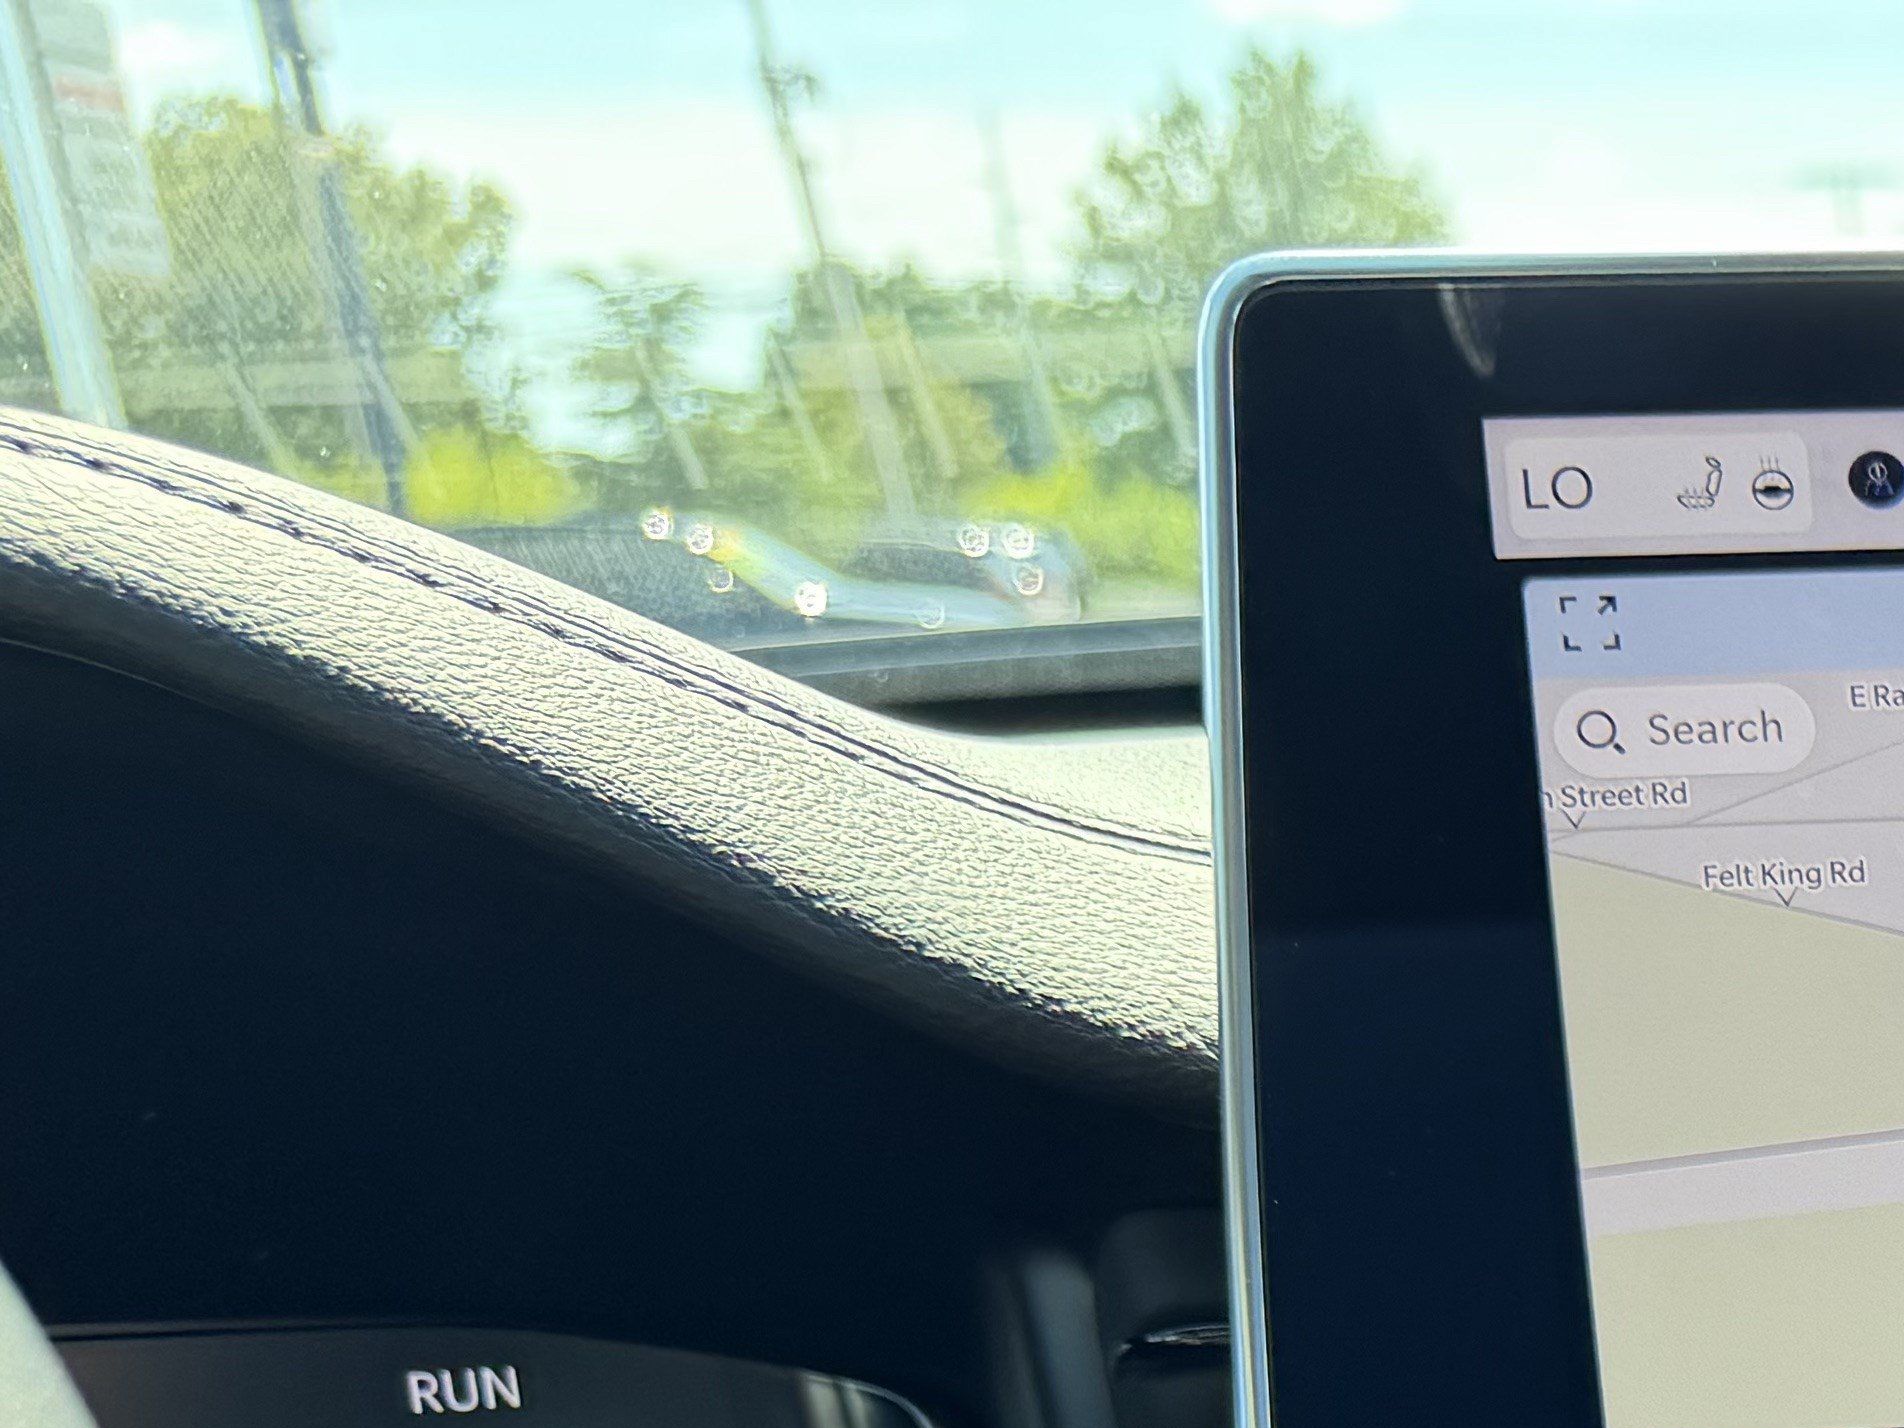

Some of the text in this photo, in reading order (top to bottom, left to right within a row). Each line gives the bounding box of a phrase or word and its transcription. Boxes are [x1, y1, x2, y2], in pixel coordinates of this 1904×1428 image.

[1522, 467, 1592, 511] LO
[1850, 684, 1864, 708] E
[1647, 709, 1783, 748] Search
[1561, 784, 1645, 809] Street
[1651, 780, 1688, 805] Rd
[1703, 859, 1865, 894] Felt King Rd
[407, 1366, 521, 1414] RUN
